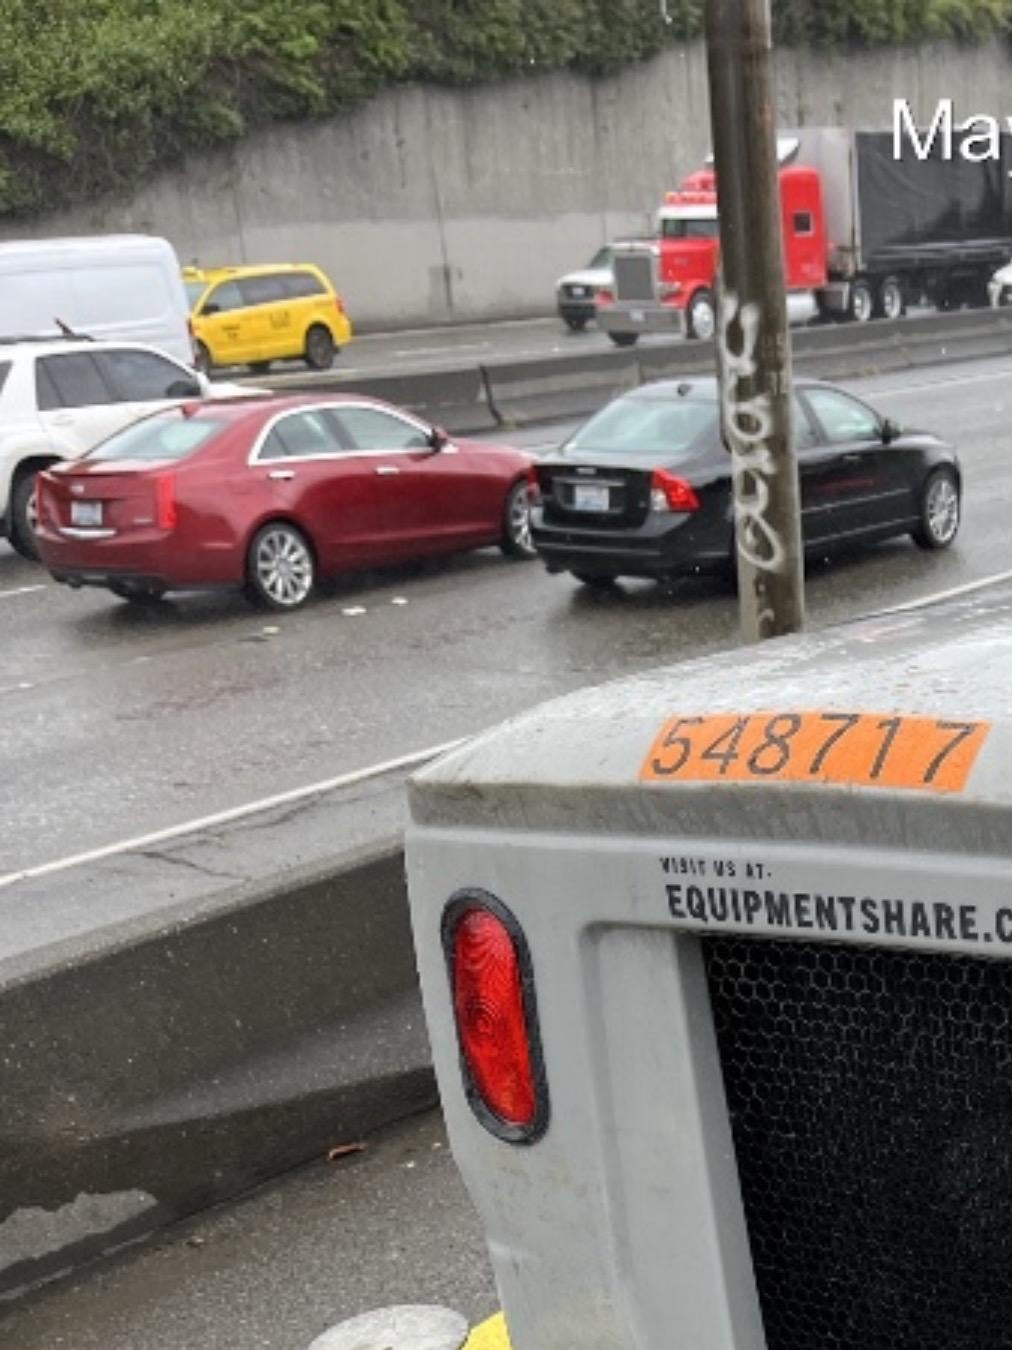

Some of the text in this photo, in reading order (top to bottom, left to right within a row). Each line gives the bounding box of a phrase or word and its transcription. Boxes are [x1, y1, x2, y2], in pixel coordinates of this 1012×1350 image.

[651, 712, 979, 786] 548717
[658, 856, 706, 877] VISIT
[713, 859, 737, 878] US
